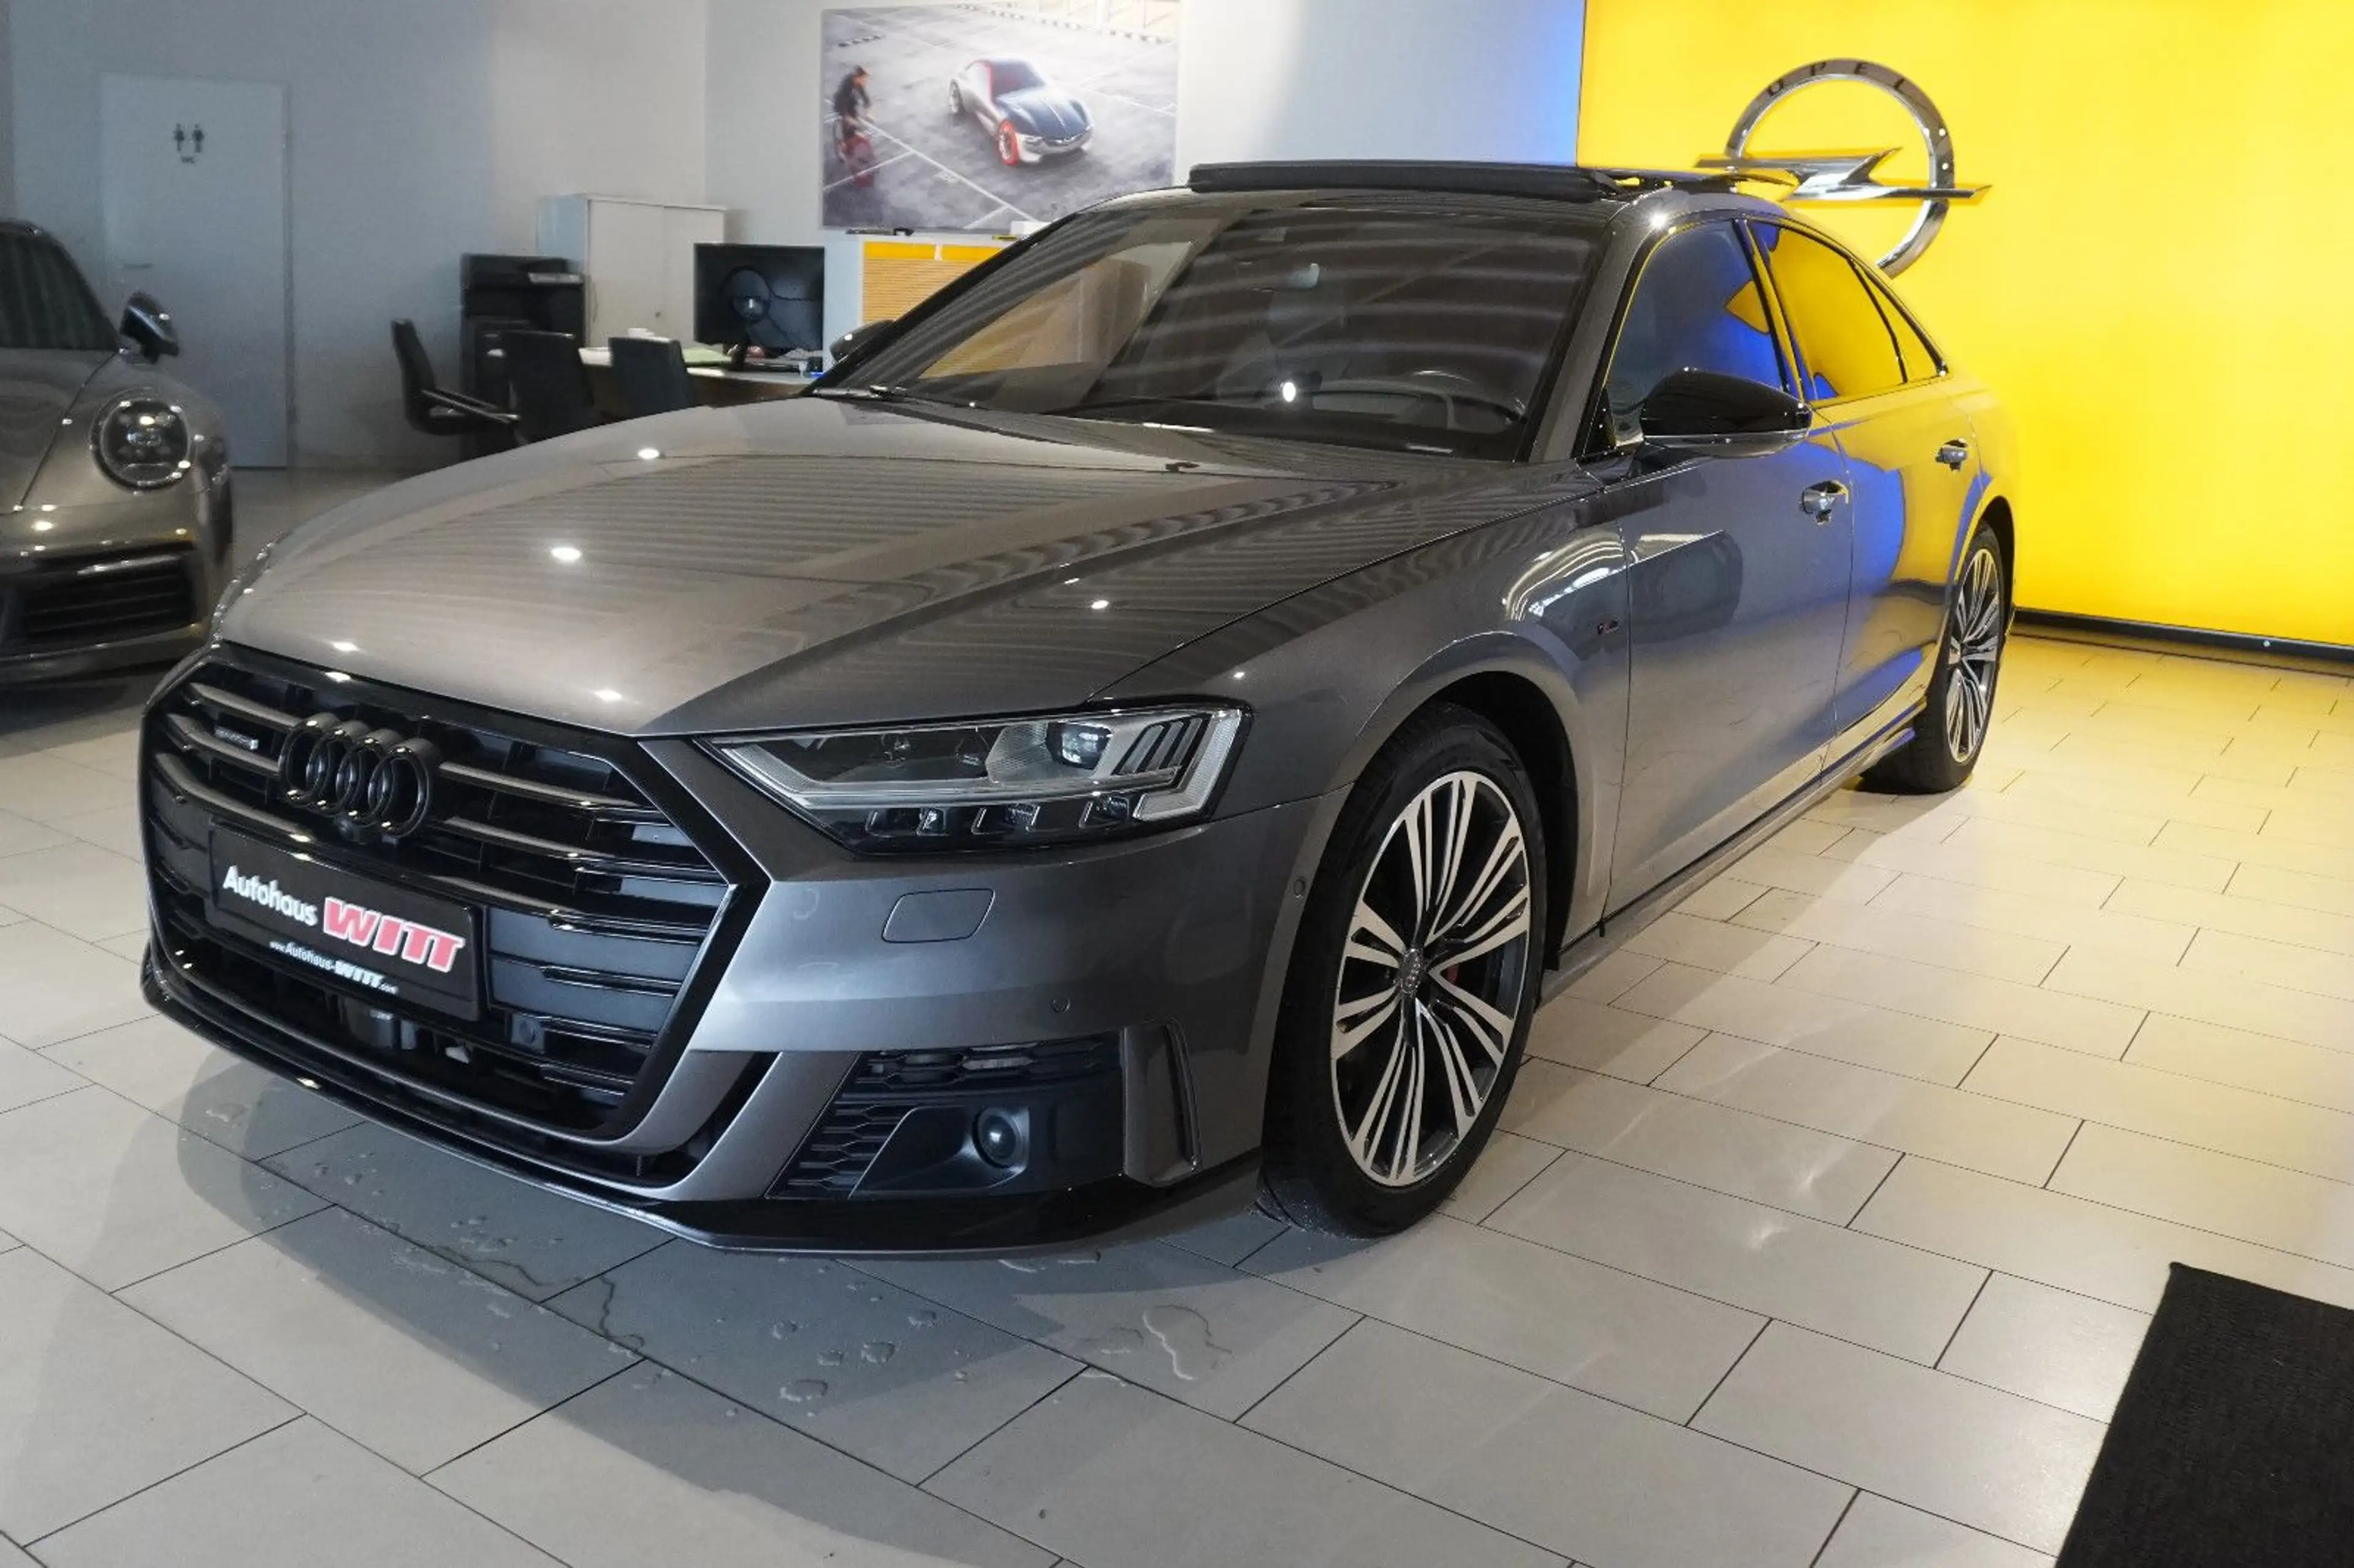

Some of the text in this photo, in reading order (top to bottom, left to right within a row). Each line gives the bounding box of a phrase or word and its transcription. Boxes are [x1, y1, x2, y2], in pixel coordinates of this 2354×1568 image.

[1769, 61, 1906, 96] OPEL
[223, 865, 466, 973] Autohaus WITT
